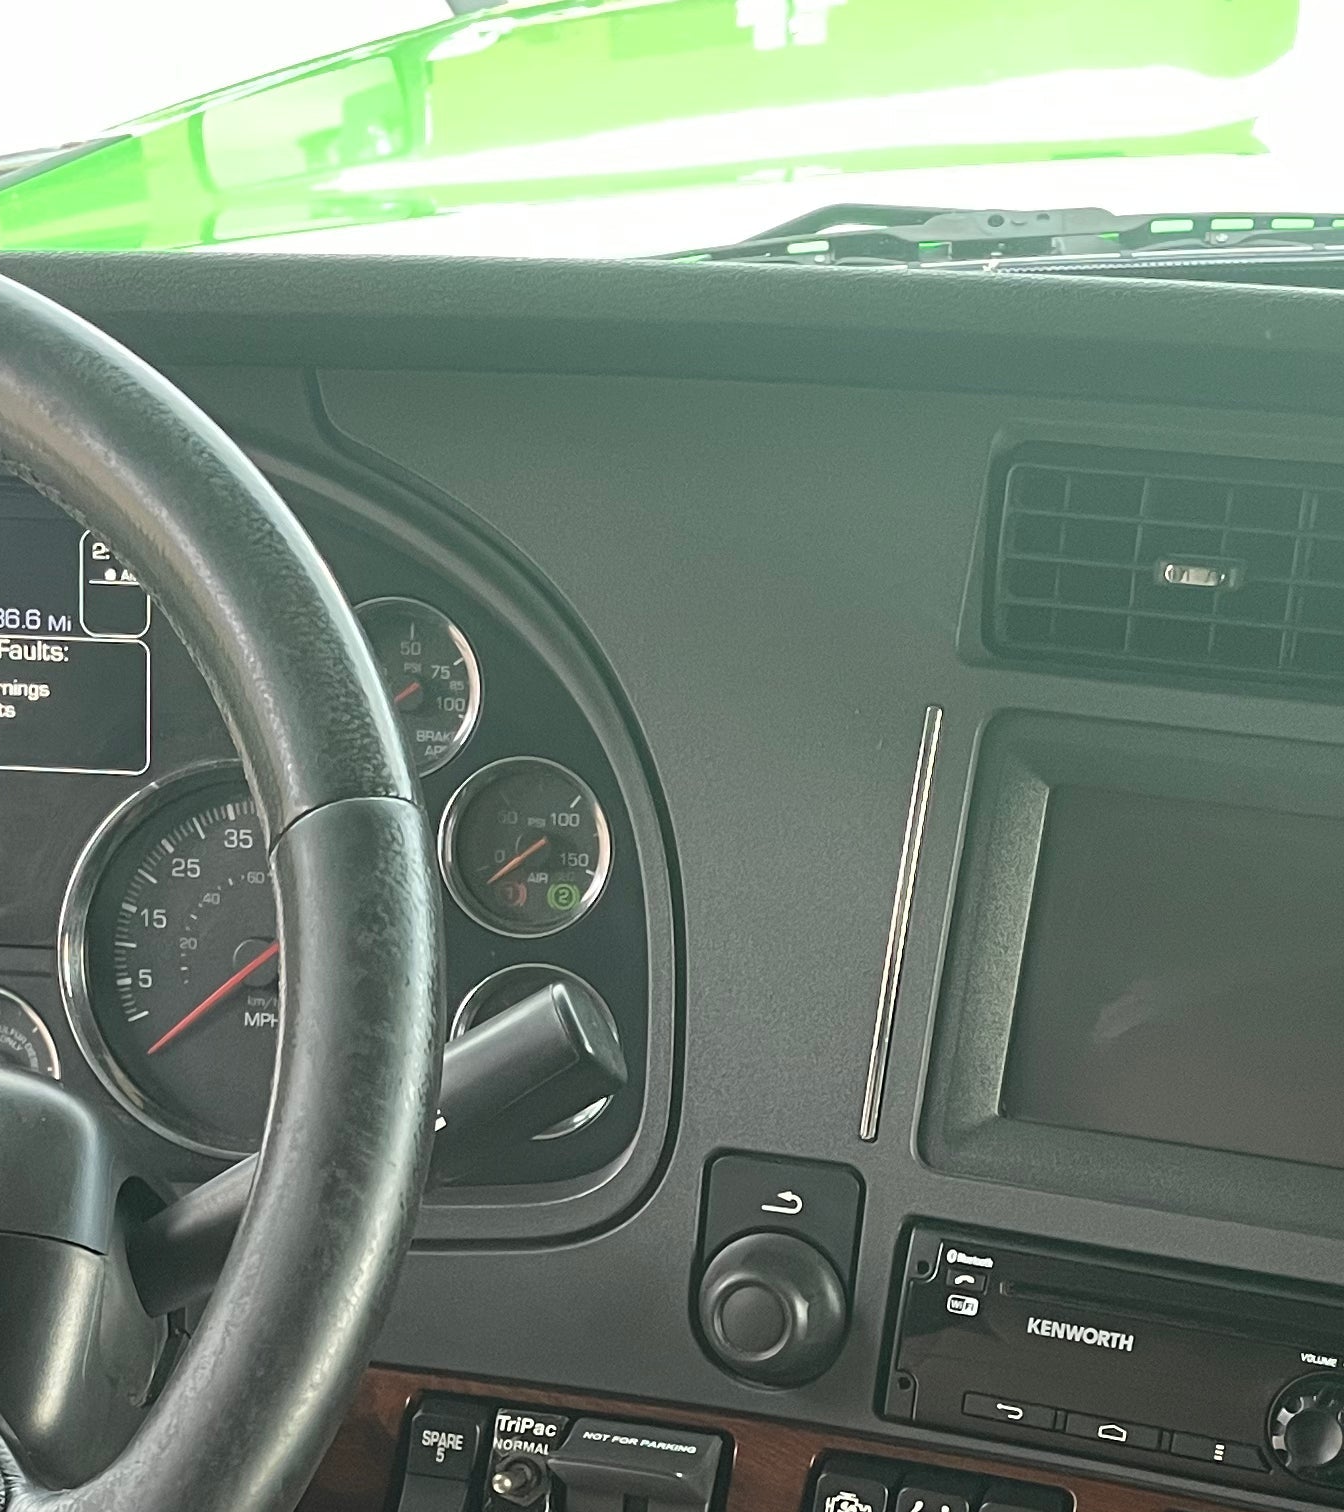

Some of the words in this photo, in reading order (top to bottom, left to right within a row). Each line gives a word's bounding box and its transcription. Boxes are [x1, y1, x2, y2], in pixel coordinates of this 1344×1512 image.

[48, 615, 72, 632] Mi
[400, 642, 421, 655] 50
[431, 665, 450, 680] 75
[437, 697, 465, 711] 100
[550, 813, 580, 827] 100
[224, 829, 253, 849] 35
[494, 851, 505, 863] 0
[560, 853, 589, 867] 150
[171, 858, 200, 878] 25
[247, 872, 265, 883] 60
[527, 873, 548, 883] AIR
[202, 893, 220, 905] 40
[140, 909, 167, 929] 15
[179, 938, 197, 950] 20
[138, 969, 152, 988] 5
[1027, 1317, 1134, 1351] KENWORTH
[1301, 1353, 1337, 1368] VOLUME
[498, 1414, 557, 1438] TriPac
[422, 1430, 464, 1451] SPARE
[492, 1437, 550, 1456] NORMAL
[583, 1431, 609, 1443] NOT
[611, 1435, 638, 1446] FOR
[639, 1439, 697, 1454] PARKING
[435, 1448, 445, 1463] 5
